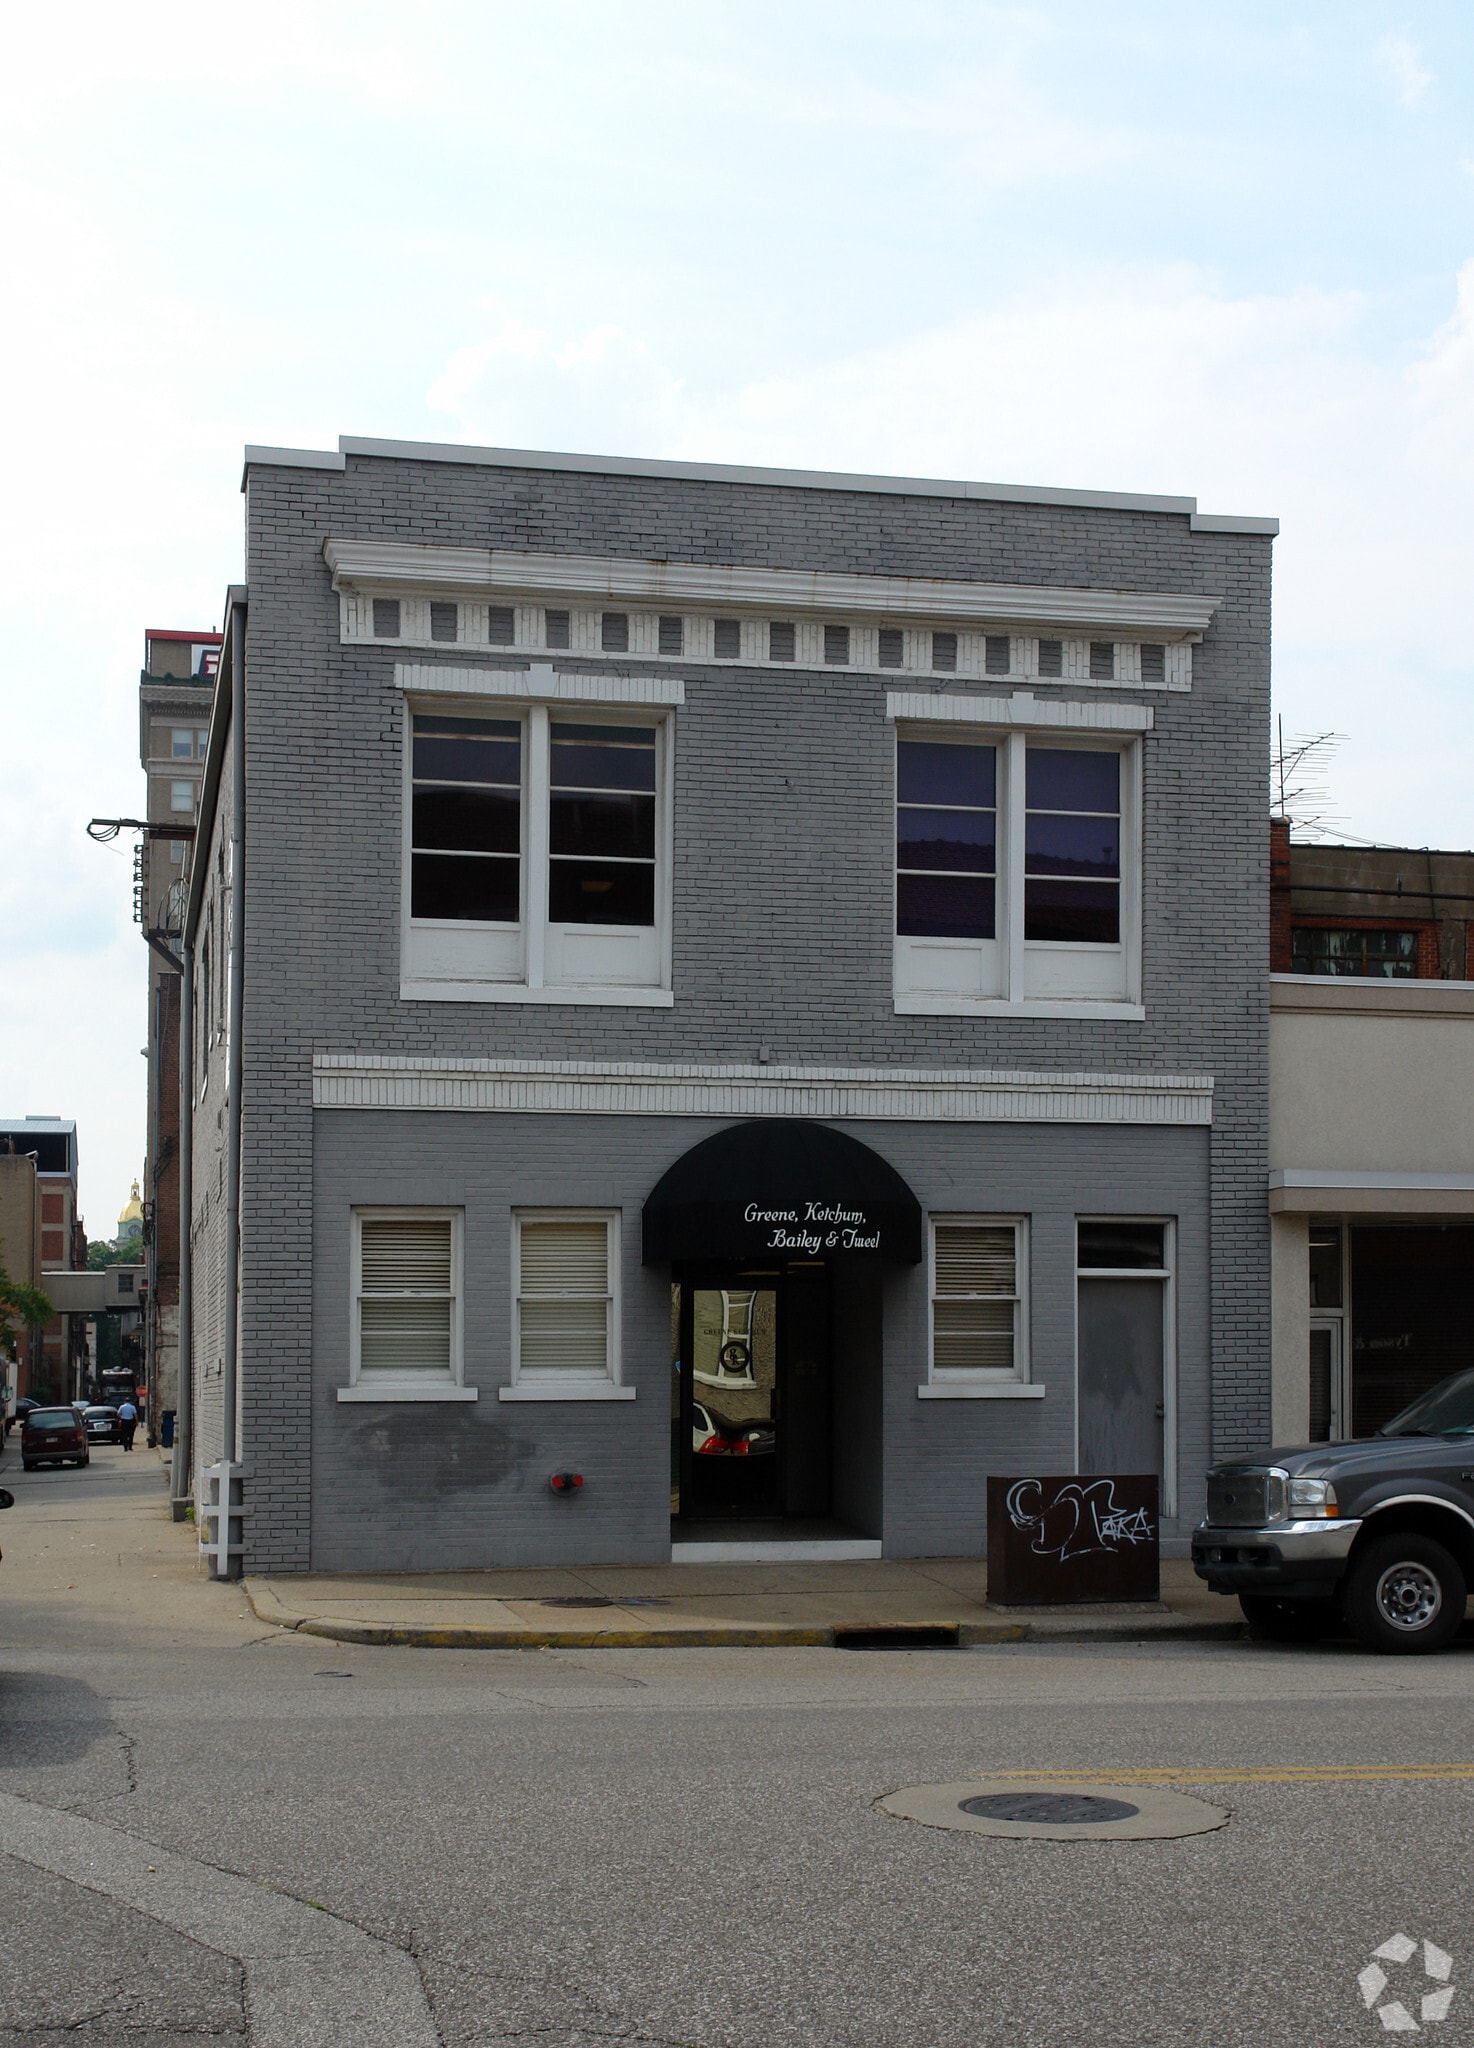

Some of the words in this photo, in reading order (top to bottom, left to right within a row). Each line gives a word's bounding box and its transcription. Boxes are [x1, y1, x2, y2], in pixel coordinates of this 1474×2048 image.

[744, 1202, 799, 1223] Greene,
[803, 1201, 867, 1225] Ketchum,
[766, 1229, 822, 1255] Bailey
[825, 1230, 840, 1247] &
[841, 1229, 881, 1249] Tweel
